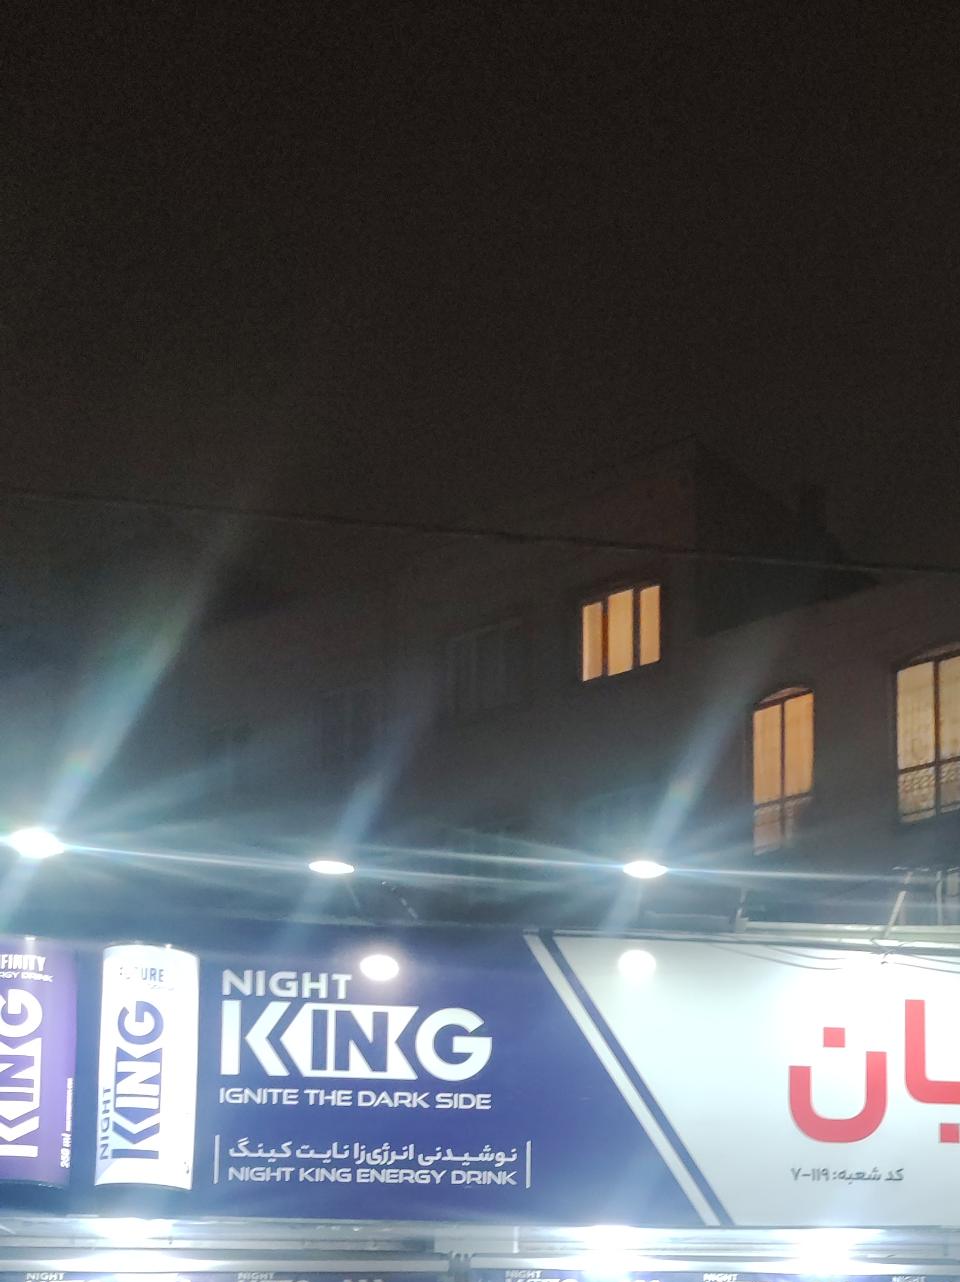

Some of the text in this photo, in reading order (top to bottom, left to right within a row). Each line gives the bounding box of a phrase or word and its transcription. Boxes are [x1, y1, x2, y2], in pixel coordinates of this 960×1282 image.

[0, 954, 46, 972] FINITY
[221, 968, 352, 999] NIGHT
[220, 1000, 493, 1082] KING
[111, 1000, 164, 1160] KING
[219, 1087, 492, 1111] IGNITE THE DARK SIDE
[100, 1088, 111, 1160] NIGHT
[228, 1136, 293, 1159] کینگ
[296, 1141, 350, 1164] نایت
[417, 1144, 518, 1167] نوشیدنی
[228, 1165, 518, 1186] NIGHT KING ENERGY DRINK
